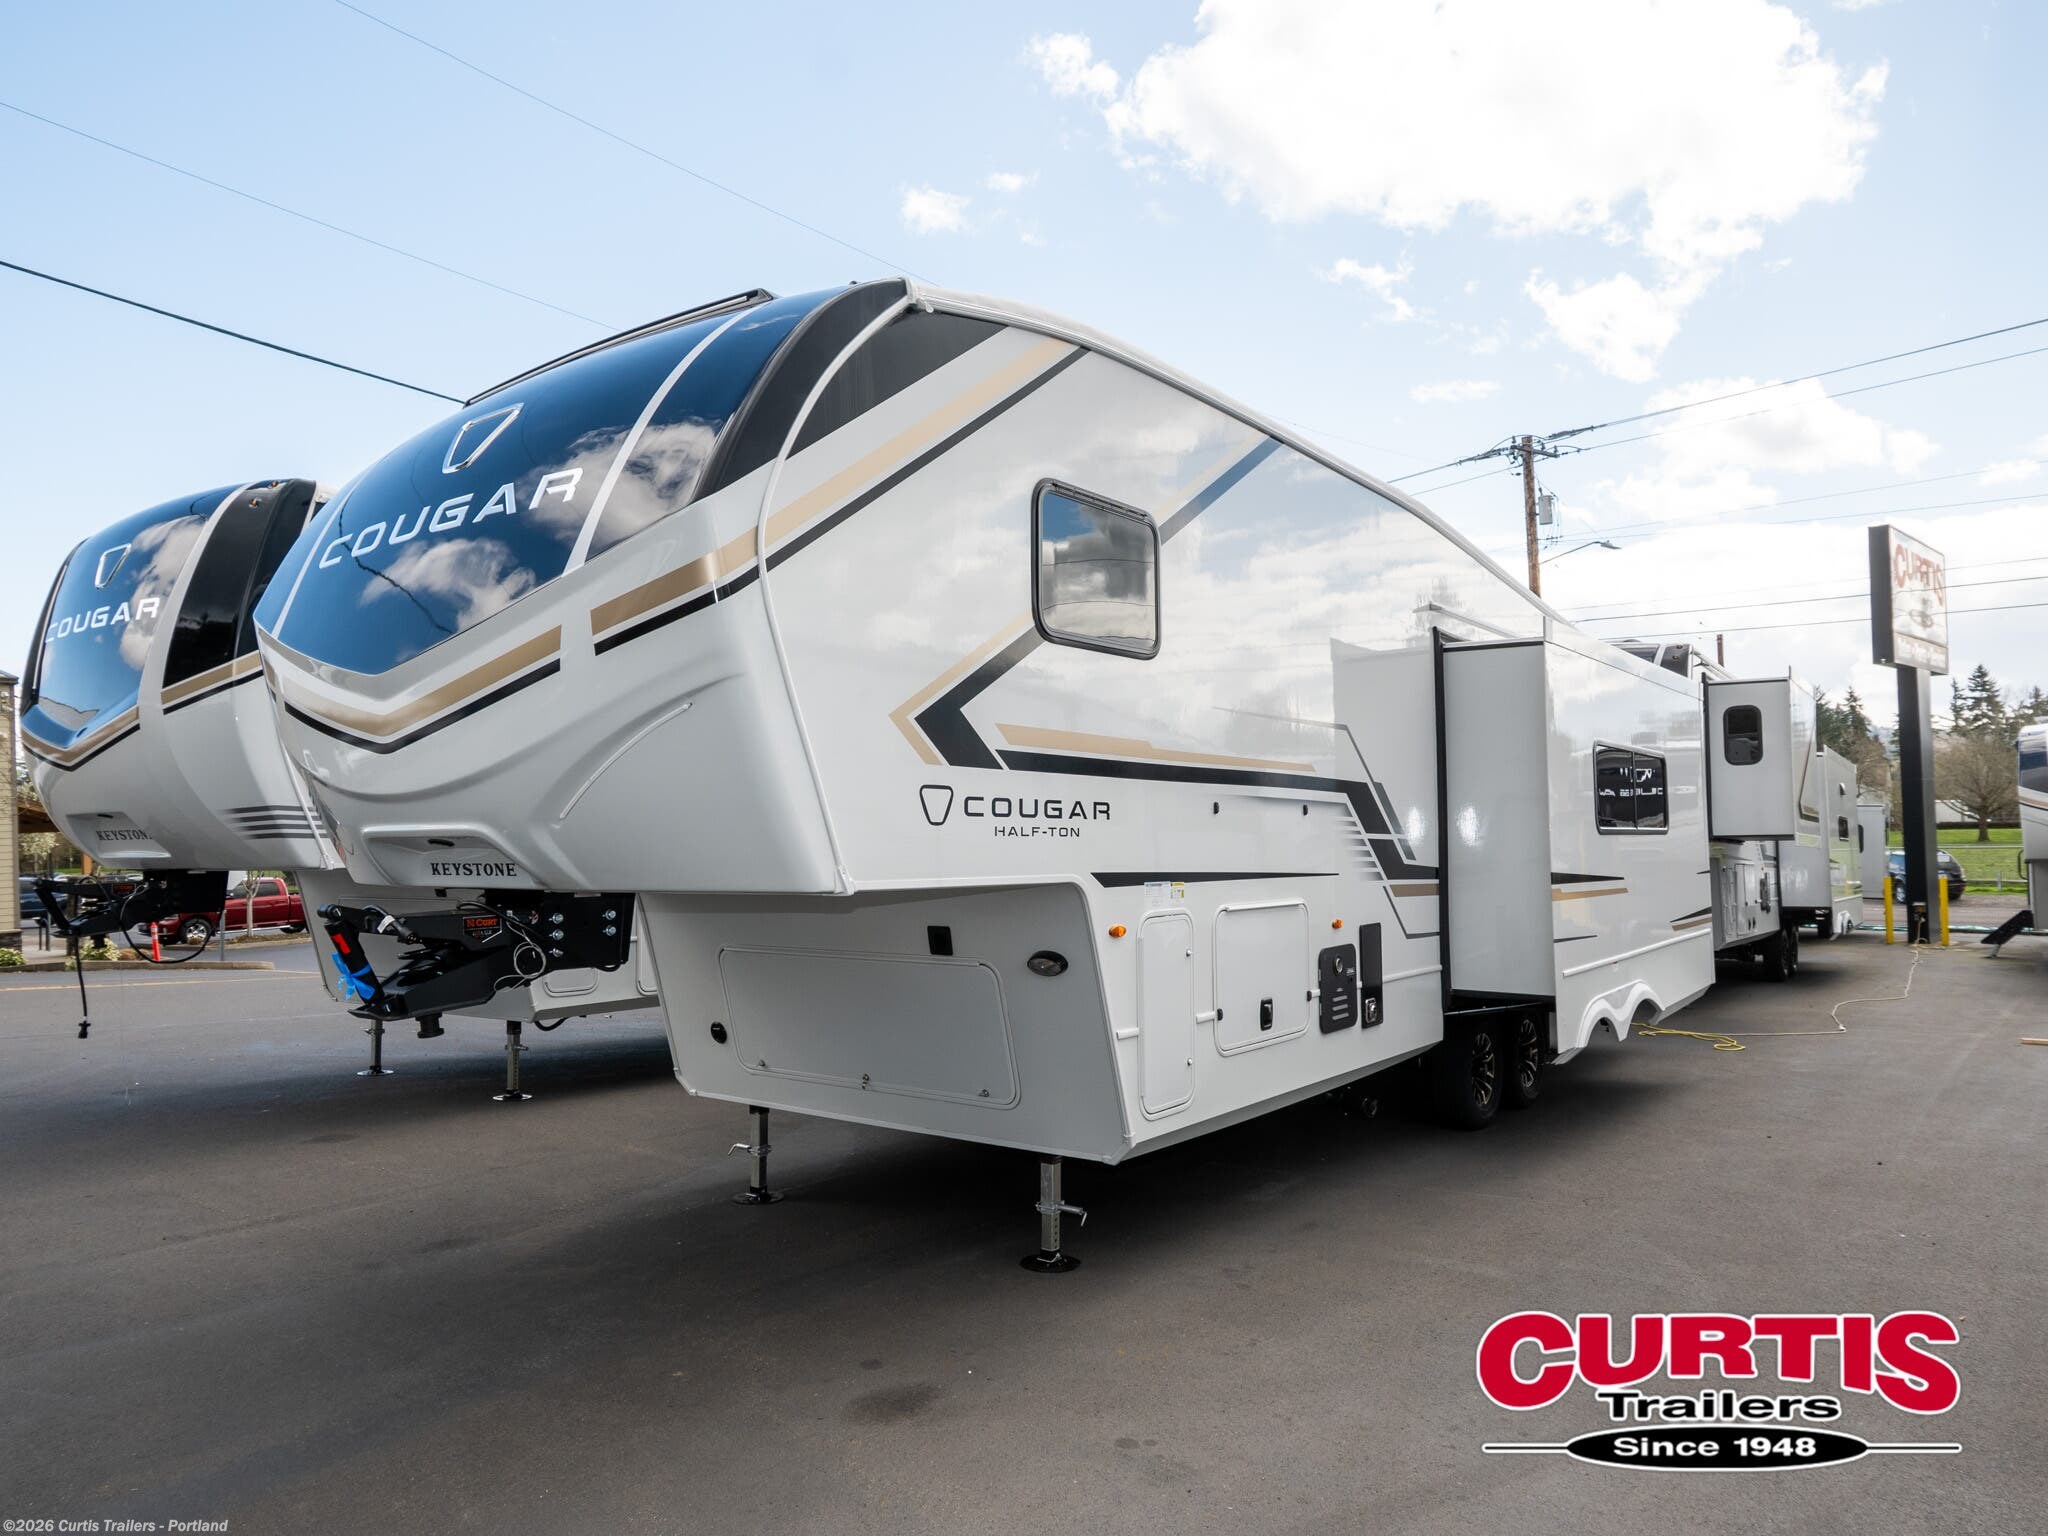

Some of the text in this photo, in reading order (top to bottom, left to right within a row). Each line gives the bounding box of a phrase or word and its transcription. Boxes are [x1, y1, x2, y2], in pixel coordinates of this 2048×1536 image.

[318, 467, 584, 569] COUGAR
[45, 597, 161, 643] COUGAR
[964, 796, 1111, 820] COUGAR
[96, 829, 153, 841] KEYSTON
[994, 826, 1080, 838] HALF-TON
[430, 862, 518, 877] KEYSTONE
